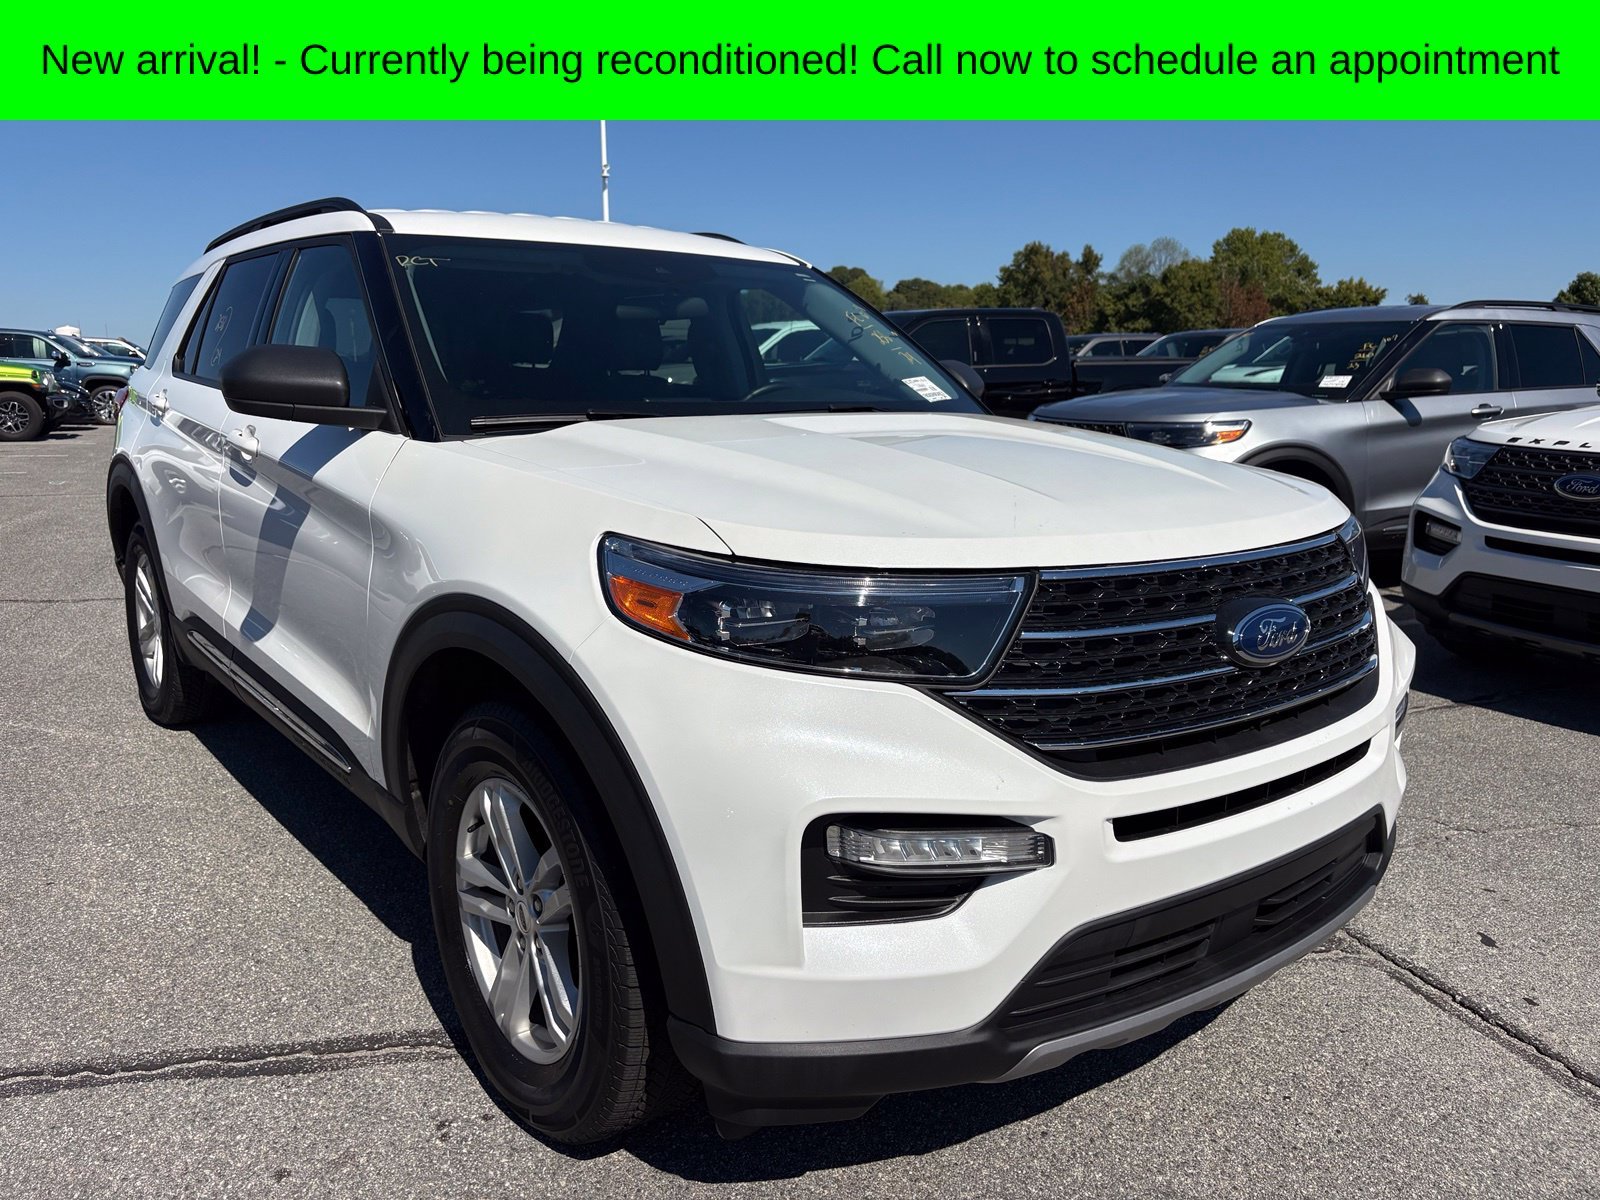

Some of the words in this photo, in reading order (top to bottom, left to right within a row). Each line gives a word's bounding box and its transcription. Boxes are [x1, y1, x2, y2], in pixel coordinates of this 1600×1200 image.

[1506, 437, 1592, 449] EXPL
[1566, 480, 1599, 494] Ford
[1257, 616, 1298, 651] Ford
